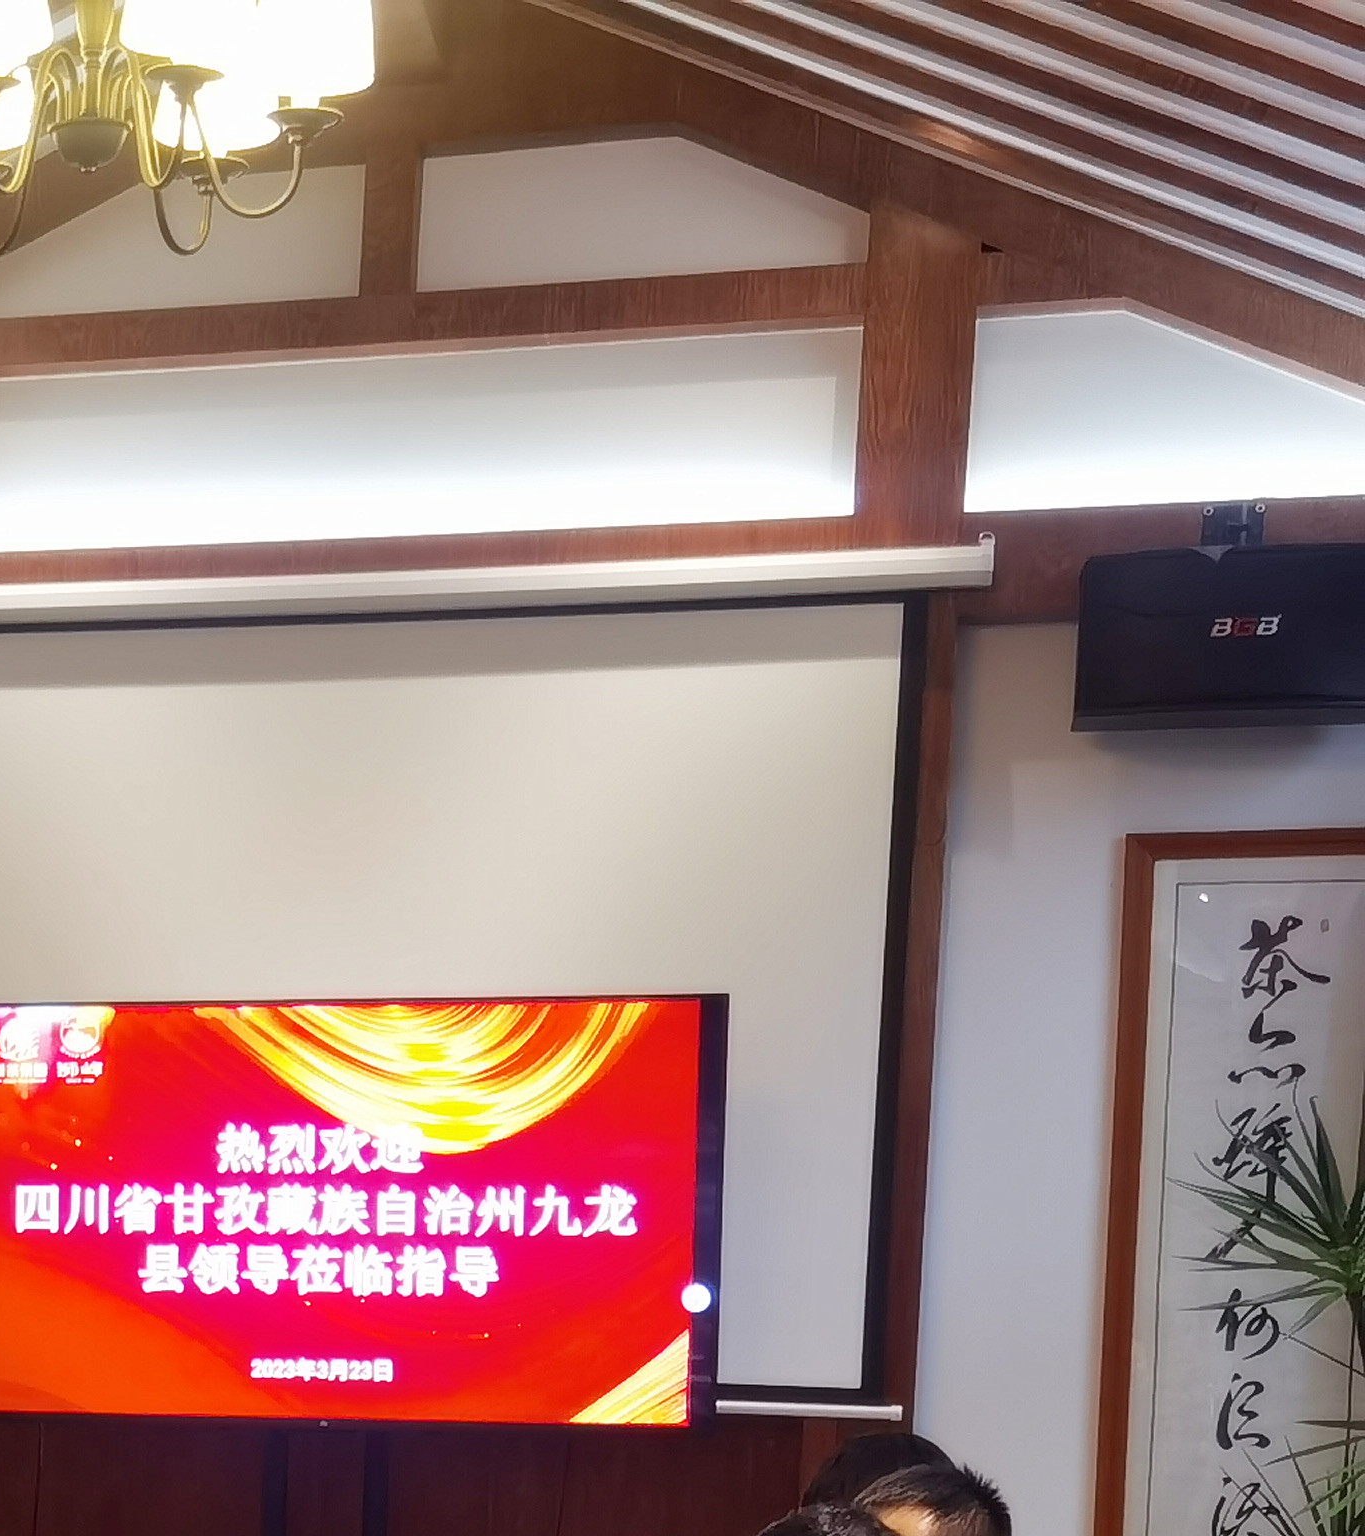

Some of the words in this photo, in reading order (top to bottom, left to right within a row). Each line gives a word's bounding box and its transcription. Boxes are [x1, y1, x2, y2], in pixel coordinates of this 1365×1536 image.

[216, 1122, 425, 1175] 热烈欢迎
[13, 1183, 638, 1239] 四川省甘孜藏族自治州九龙
[138, 1244, 500, 1298] 县领导莅临指导
[250, 1356, 393, 1383] 2023年3月23日
